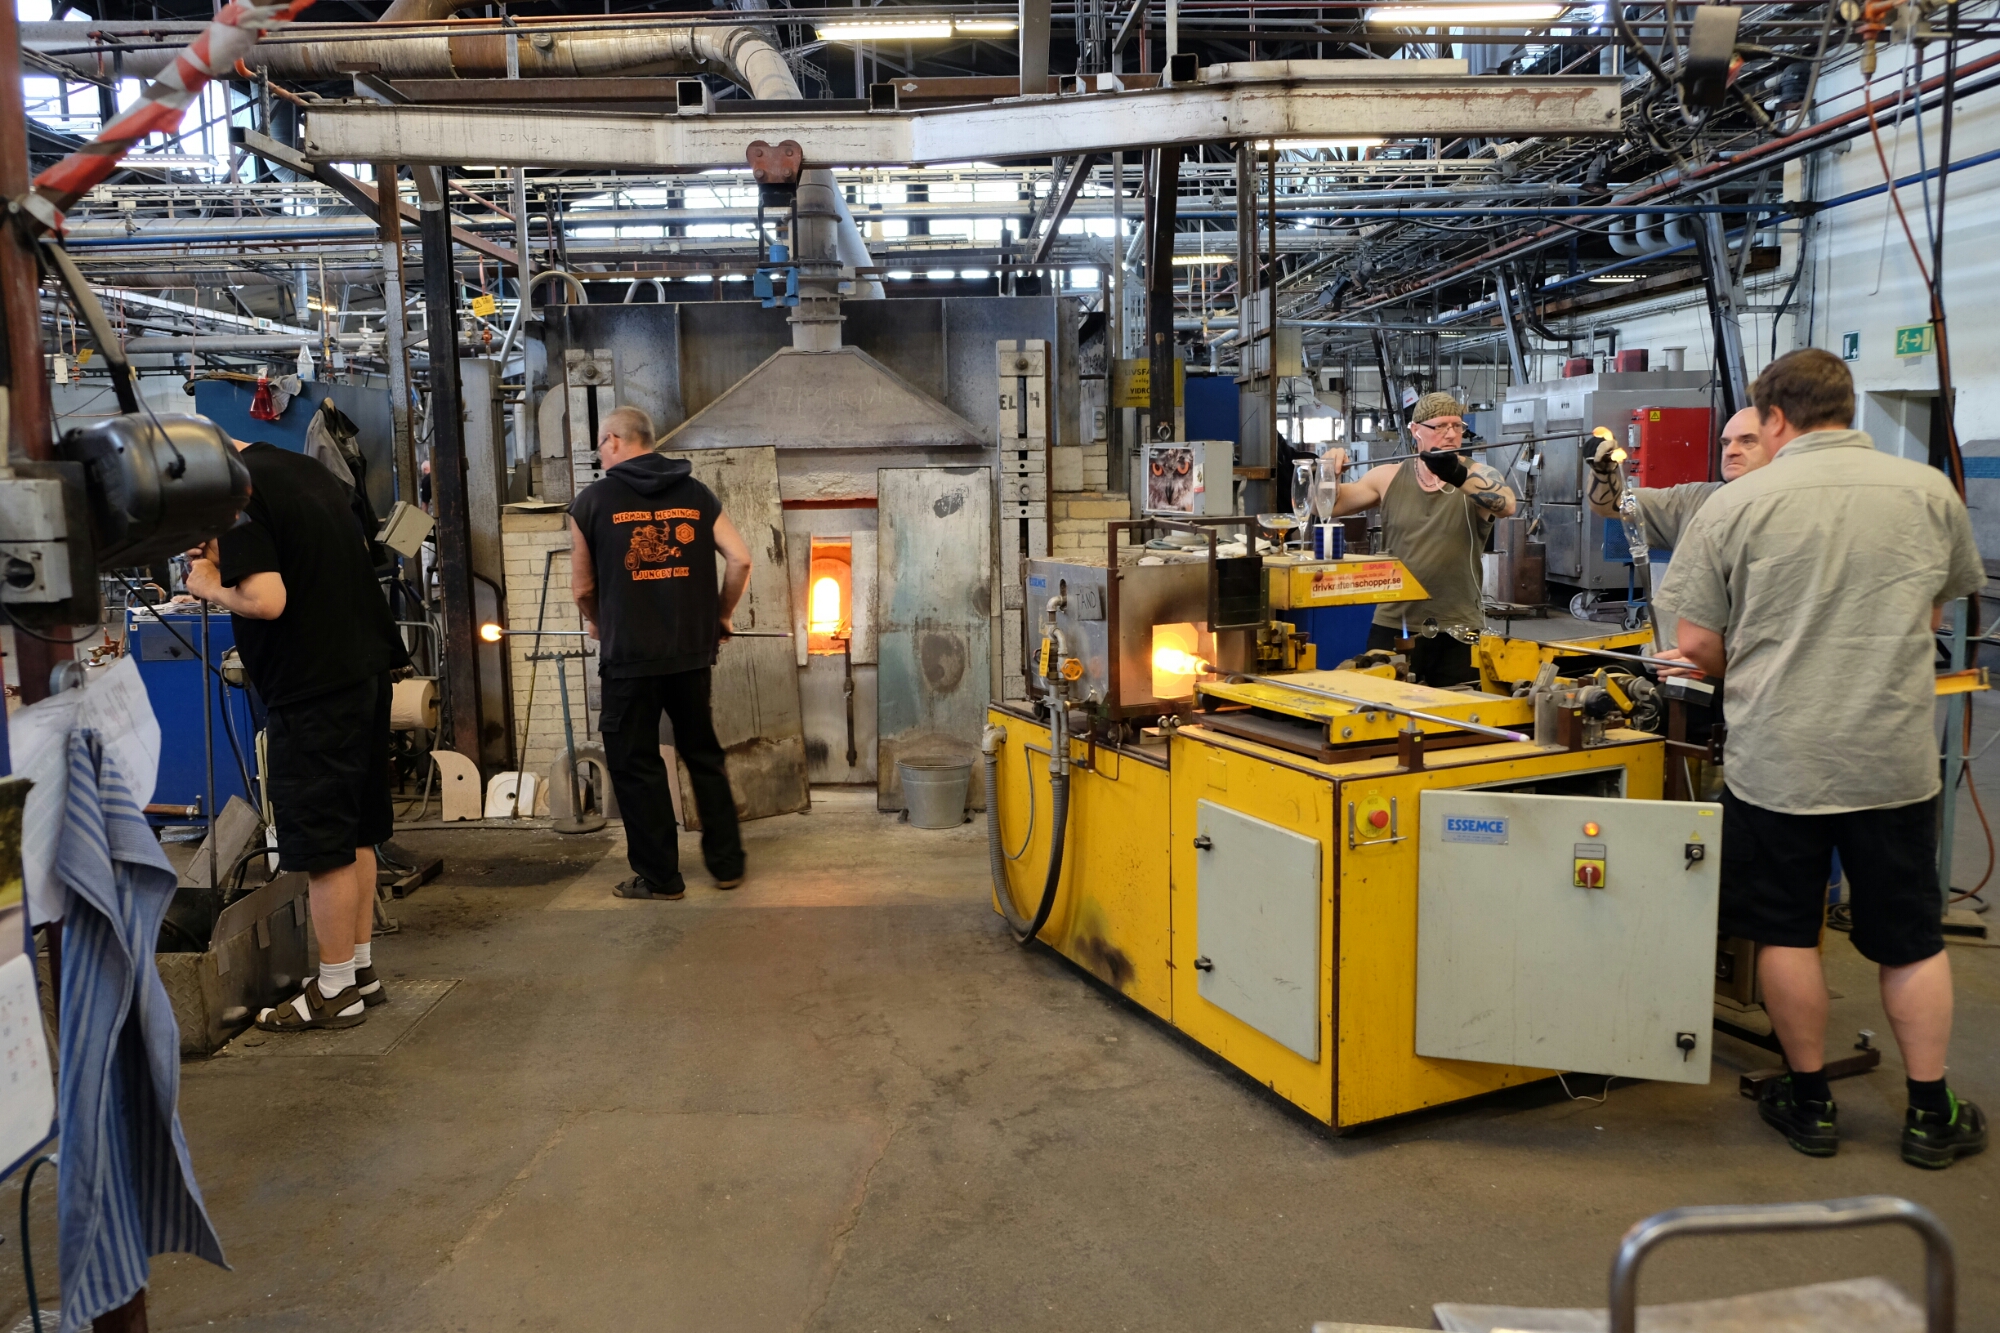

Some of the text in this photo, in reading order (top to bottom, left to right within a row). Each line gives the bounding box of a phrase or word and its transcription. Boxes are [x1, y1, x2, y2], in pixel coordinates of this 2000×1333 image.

[1124, 368, 1150, 376] LIVSFA
[1029, 391, 1040, 408] 4
[612, 508, 701, 524] HERMANS HEDNINGAR
[632, 568, 672, 581] LJUNGBY
[1447, 818, 1504, 834] ESSEMCE
